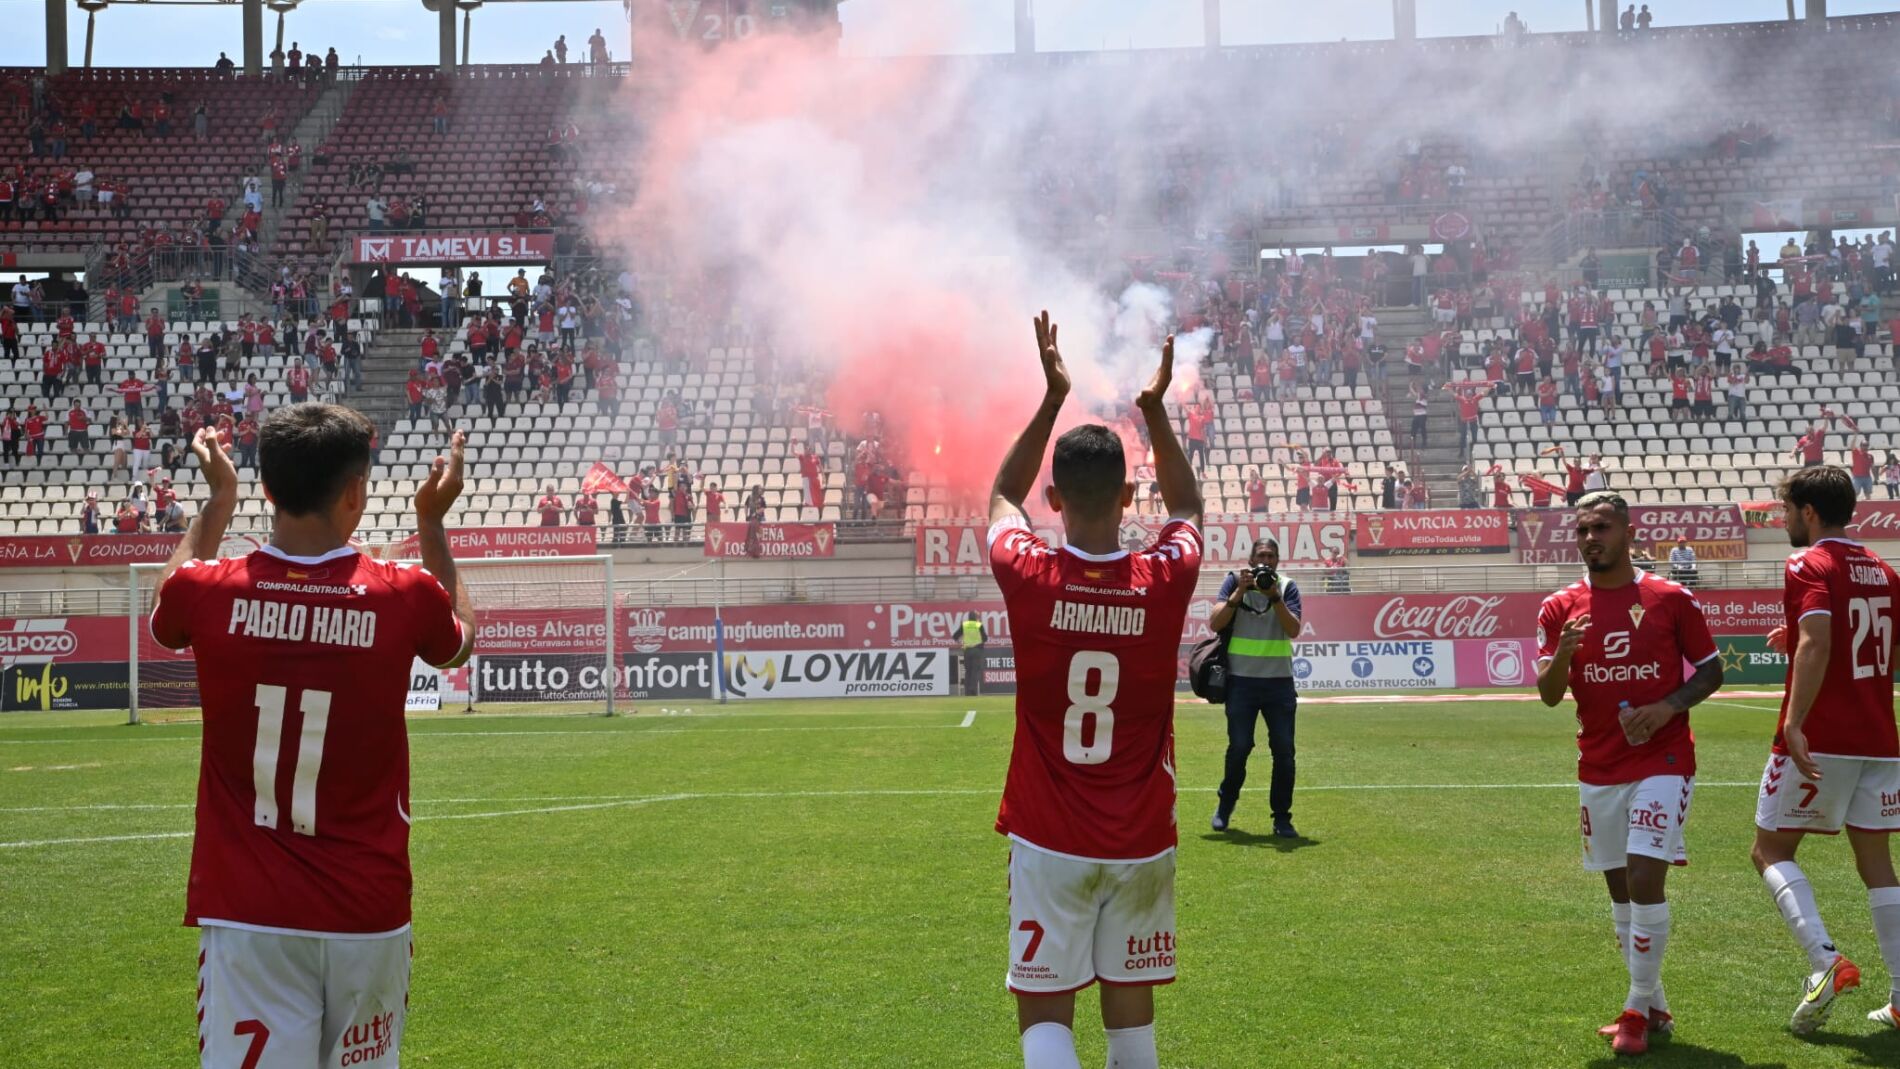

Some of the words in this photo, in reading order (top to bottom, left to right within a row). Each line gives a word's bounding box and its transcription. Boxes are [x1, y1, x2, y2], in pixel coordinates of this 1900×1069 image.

[702, 14, 722, 40] 2
[734, 15, 754, 40] 0
[401, 238, 489, 257] TAMEVI
[497, 237, 541, 256] S.L.
[1393, 516, 1458, 530] MURCIA
[1464, 515, 1501, 529] 2008
[1640, 511, 1733, 525] GRANA
[450, 532, 488, 548] PEÑA
[496, 531, 592, 545] MURCIANISTA
[757, 524, 784, 541] EÑA
[1634, 526, 1688, 541] CON
[1694, 525, 1744, 540] DEL
[35, 546, 57, 558] LA
[89, 543, 176, 558] CONDOMIN
[760, 541, 813, 556] LORAOS
[924, 528, 983, 564] RA
[1204, 524, 1346, 562] RANAS
[1523, 550, 1574, 564] REAL
[256, 580, 351, 596] COMPRALAENTRADA
[1065, 583, 1136, 597] COMPRALAENTRADA
[1701, 604, 1721, 615] ria
[1724, 602, 1745, 615] de
[1748, 600, 1785, 615] Jesú
[228, 598, 307, 642] PABLO
[310, 606, 377, 648] HARO
[890, 604, 1010, 638] Prevm
[1050, 599, 1146, 636] ARMANDO
[1373, 595, 1506, 639] Coca-Cola
[1705, 615, 1787, 628] rio-Crematori
[476, 621, 537, 638] uebles
[542, 620, 606, 638] Alvare
[668, 621, 845, 643] campngfuente.com
[1848, 596, 1893, 680] 25
[573, 637, 584, 647] de
[1292, 643, 1339, 657] VENT
[1345, 641, 1434, 657] LEVANTE
[780, 651, 937, 683] LOYMAZ
[985, 657, 1001, 668] THE
[1002, 657, 1016, 668] TES
[1583, 660, 1661, 683] fibranet
[412, 674, 439, 692] DA
[481, 660, 569, 692] tutto
[579, 656, 710, 690] confort
[16, 662, 68, 711] info
[845, 680, 934, 695] promociones
[1294, 680, 1309, 689] OS
[1311, 680, 1342, 689] PARA
[1345, 678, 1437, 688] CONSTRUCCIÓN
[406, 696, 438, 706] aFrio
[538, 690, 648, 700] TuttoConfortMucia.com
[1062, 650, 1120, 765] 8
[253, 683, 333, 837] 11
[1799, 782, 1819, 808] 7
[1580, 805, 1593, 837] 9
[1630, 808, 1668, 830] CRC
[1880, 807, 1900, 817] con
[1018, 920, 1045, 963] 7
[1014, 963, 1051, 973] Televisión
[234, 1018, 271, 1069] 7
